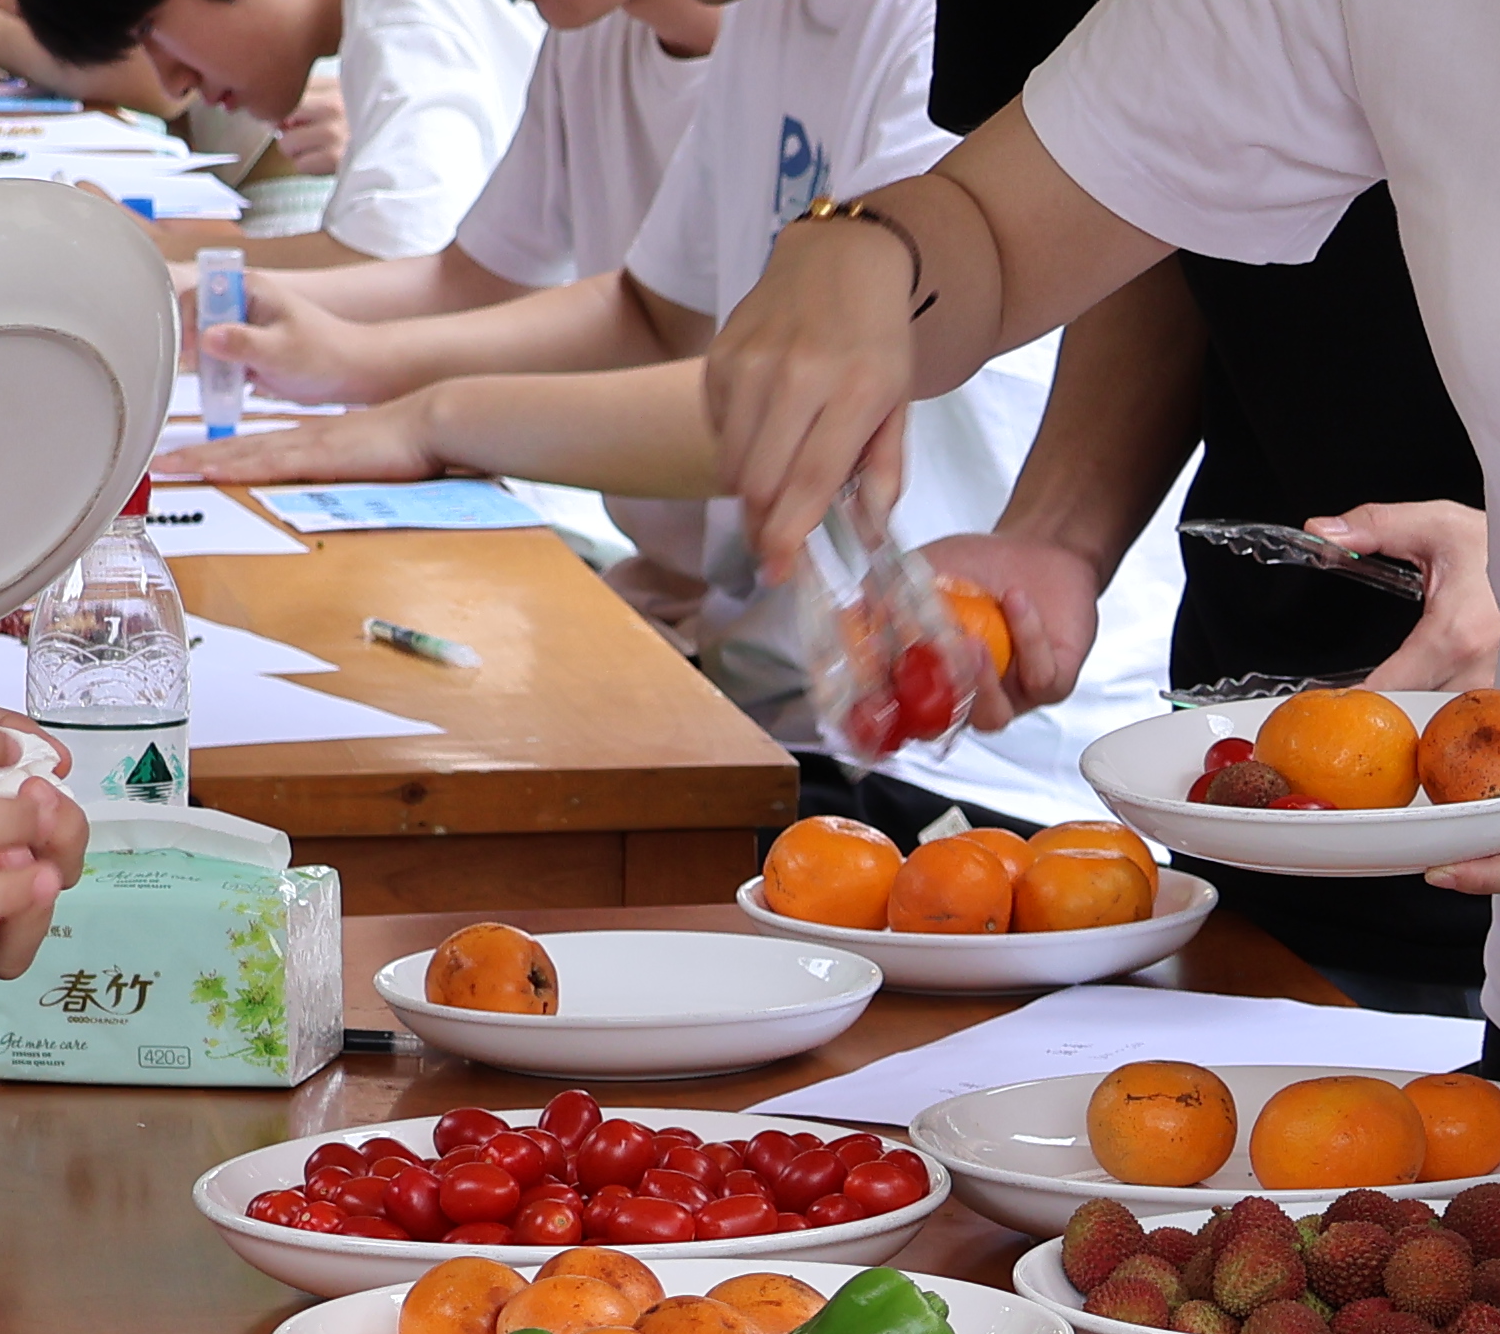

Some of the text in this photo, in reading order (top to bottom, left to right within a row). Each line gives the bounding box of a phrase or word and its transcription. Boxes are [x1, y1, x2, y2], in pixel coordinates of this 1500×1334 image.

[46, 925, 73, 939] 纸业
[41, 969, 155, 1014] 春竹
[59, 1038, 89, 1051] care
